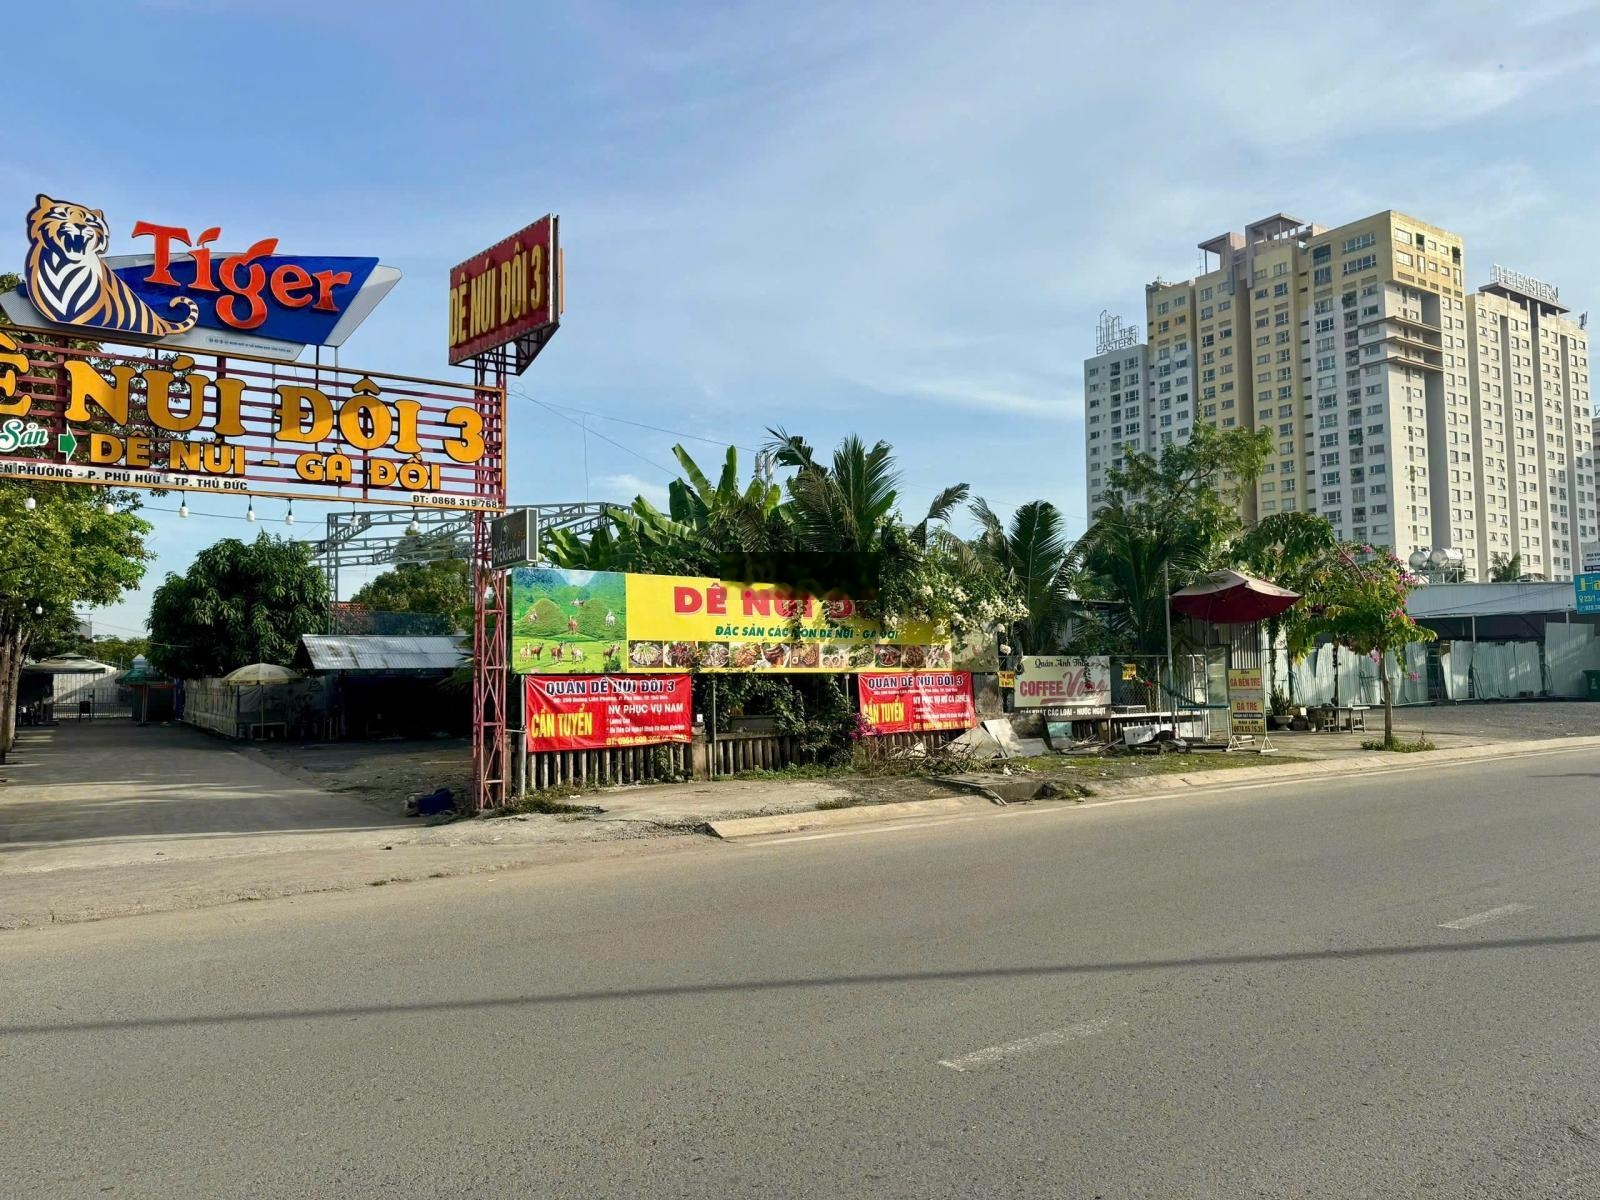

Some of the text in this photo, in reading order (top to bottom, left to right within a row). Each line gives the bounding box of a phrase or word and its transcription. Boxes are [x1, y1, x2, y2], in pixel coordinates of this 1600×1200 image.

[131, 220, 352, 329] Tiger
[1515, 272, 1559, 302] EASTERN
[450, 272, 467, 346] DÊ
[470, 258, 496, 338] NÚI
[530, 244, 543, 310] 3
[1096, 325, 1136, 354] THE EASTERN
[64, 355, 246, 436] NÚI
[275, 379, 422, 454] ĐÔI
[443, 406, 486, 463] 3
[90, 431, 441, 490] DÊ NÚI GÀ ĐỒI
[18, 464, 73, 477] PHƯỜNG
[87, 470, 100, 480] P.
[104, 471, 131, 482] PHÚ
[135, 473, 161, 484] HỮU
[174, 477, 193, 487] TP.
[197, 477, 220, 489] THỦ
[223, 480, 248, 490] ĐỨC
[413, 495, 497, 509] ĐT: 0868 319 768
[674, 582, 727, 616] DÊ
[715, 624, 739, 638] ĐẶC
[742, 624, 765, 637] SẢN
[768, 625, 789, 637] CÁC
[667, 679, 675, 692] 3
[956, 675, 963, 687] 3
[1019, 680, 1065, 697] COFFEE
[557, 703, 593, 736] TUYỂN
[608, 703, 684, 716] NV PHỤC VỤ NAM
